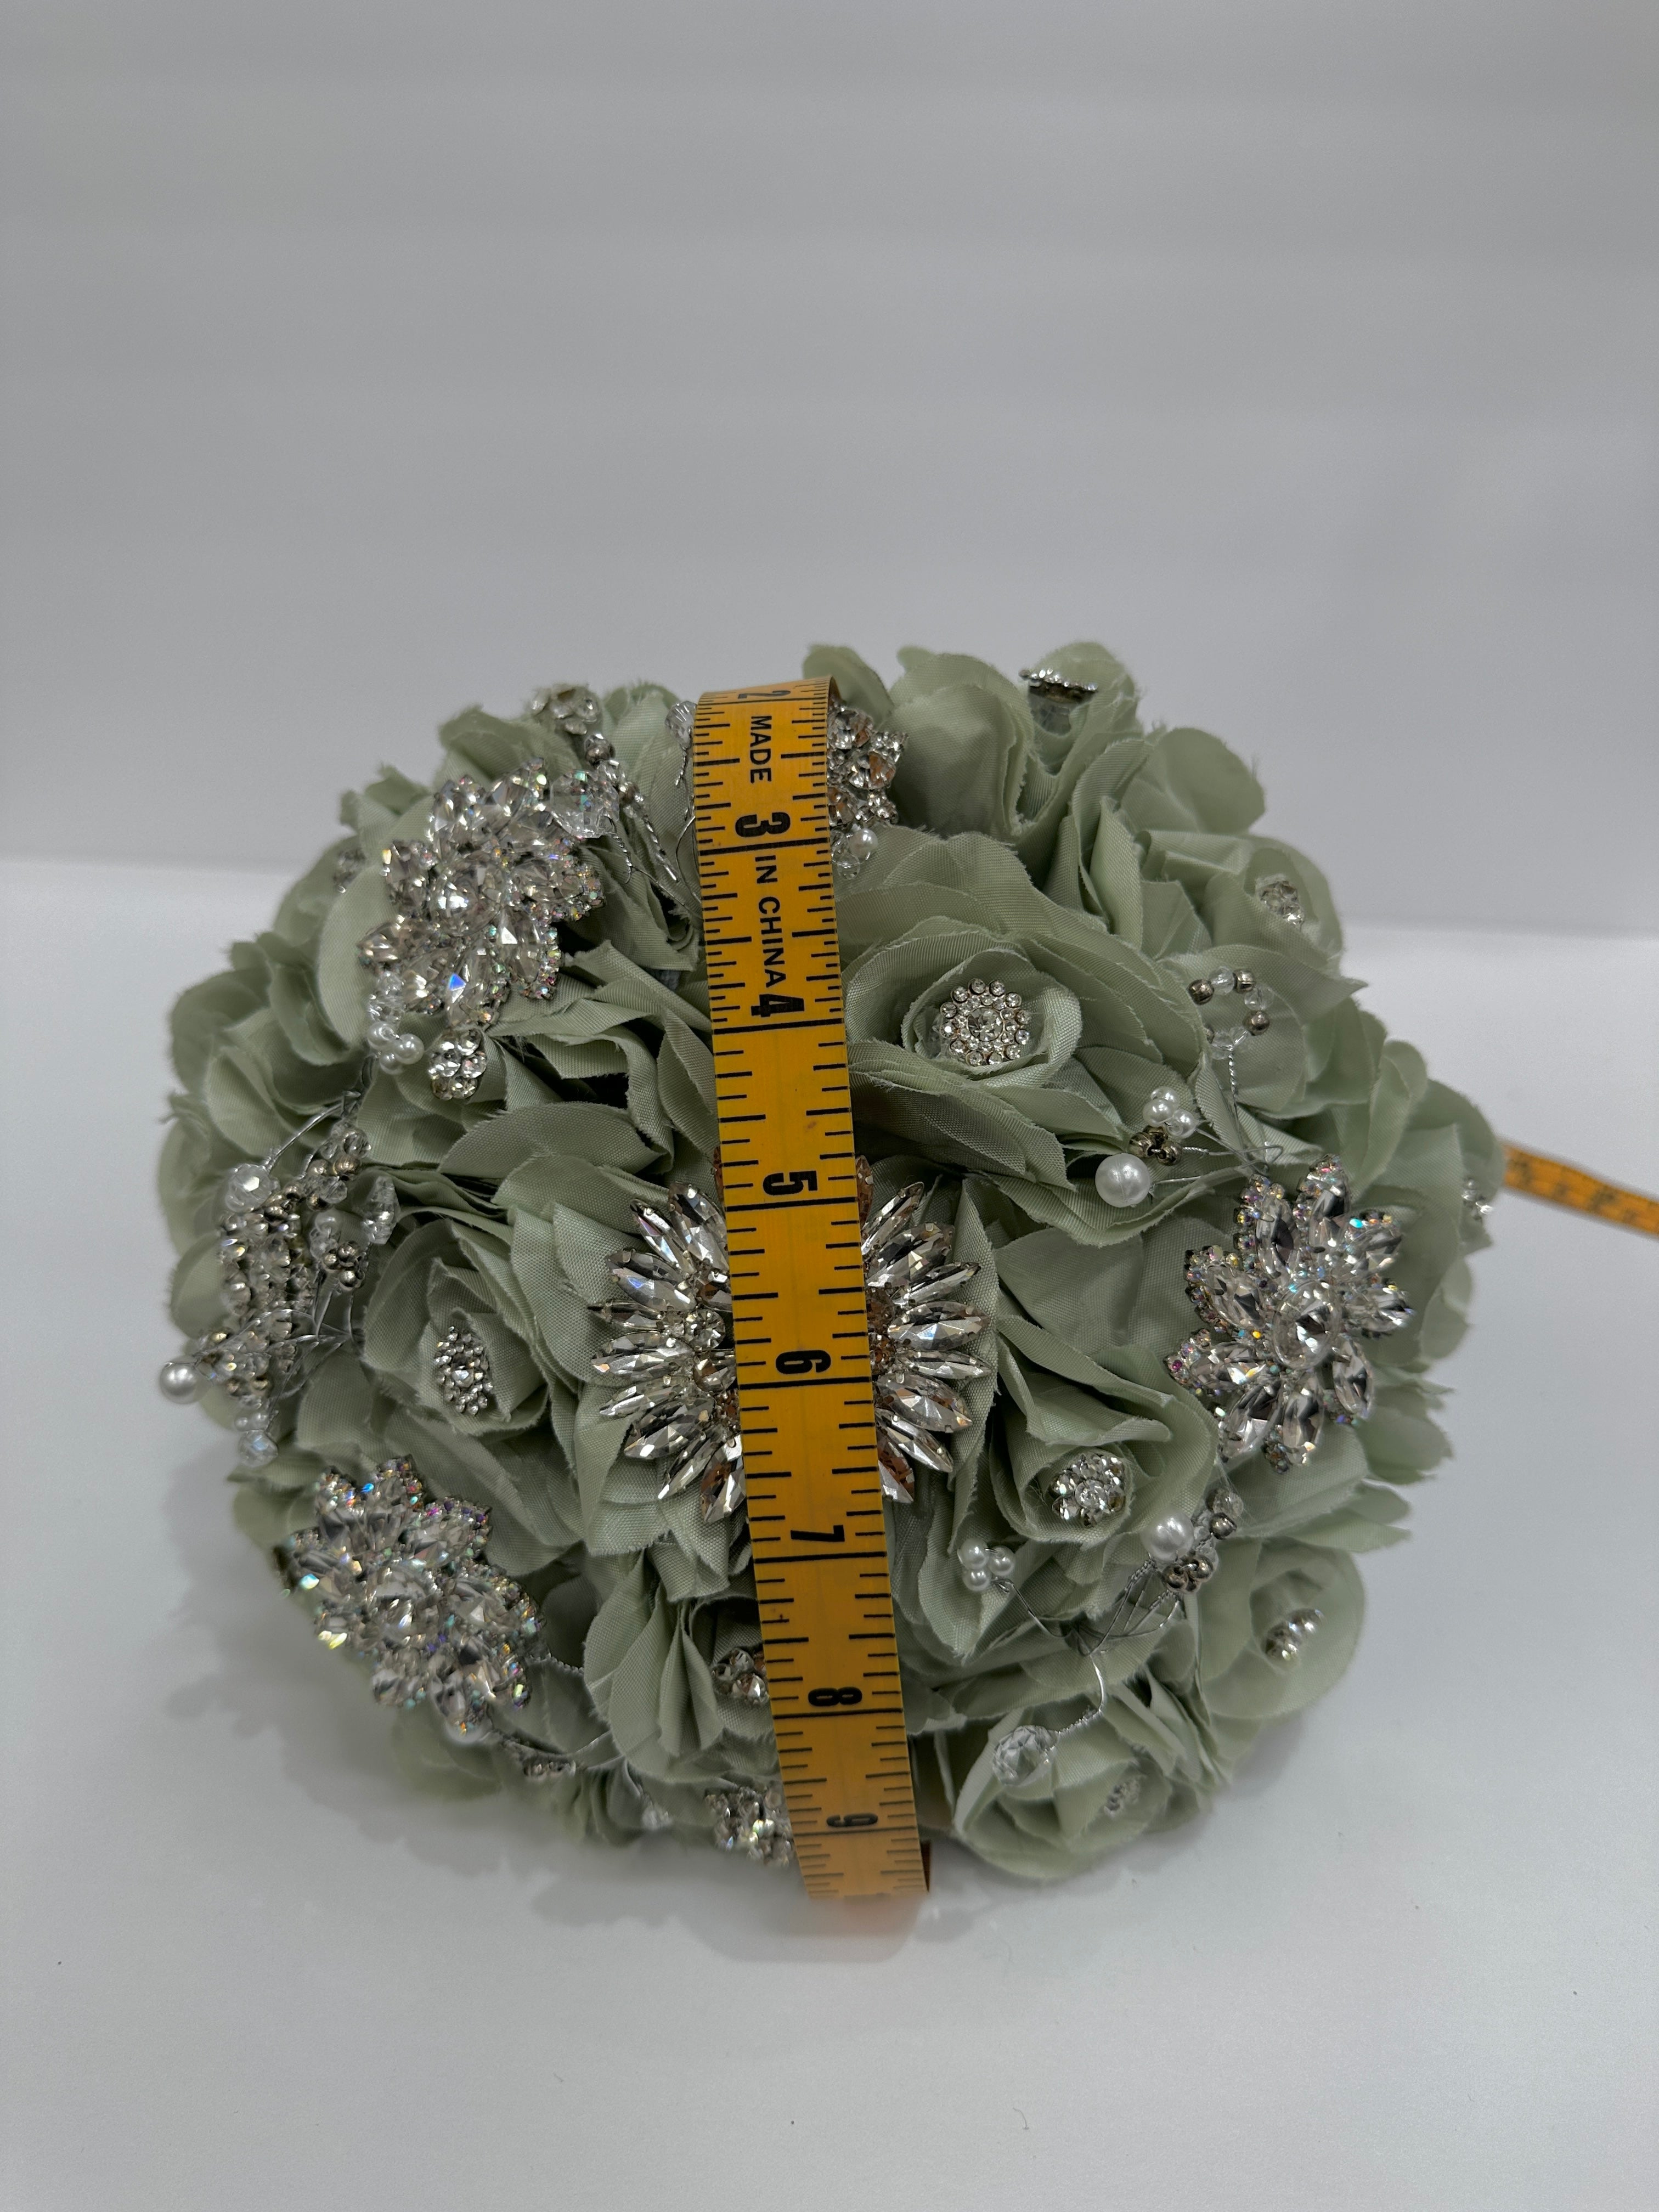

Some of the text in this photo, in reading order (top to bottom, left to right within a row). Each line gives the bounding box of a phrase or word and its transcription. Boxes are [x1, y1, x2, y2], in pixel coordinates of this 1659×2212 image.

[735, 812, 791, 838] 3
[749, 715, 787, 988] MADE IN CHINA
[751, 994, 804, 1017] 4
[763, 1170, 818, 1195] 5
[775, 1350, 831, 1374] 6
[790, 1525, 845, 1542] 7
[808, 1686, 862, 1707] 8
[826, 1813, 878, 1827] 9
